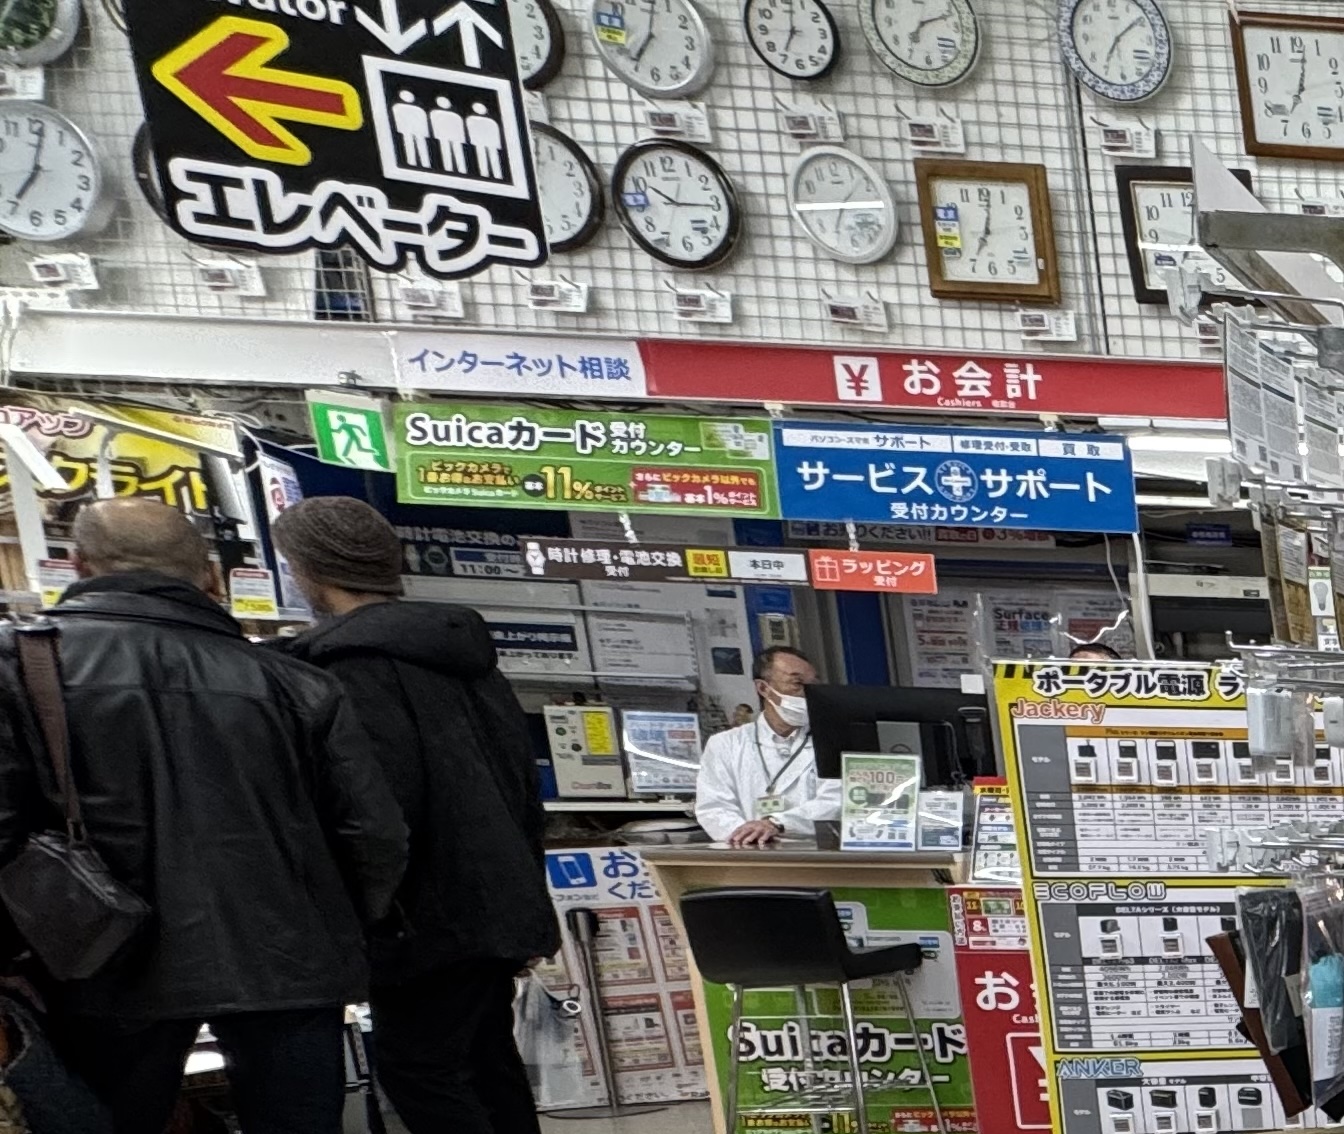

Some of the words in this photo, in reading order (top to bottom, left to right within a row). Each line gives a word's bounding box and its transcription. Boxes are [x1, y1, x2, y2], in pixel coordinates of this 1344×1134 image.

[168, 156, 539, 273] エレベーター
[408, 348, 631, 381] インターネット相談
[901, 358, 1043, 400] お会計
[937, 397, 982, 408] Cashiers
[407, 413, 607, 454] Suicaカード
[610, 421, 646, 440] 受付
[611, 439, 702, 457] カウンター
[874, 434, 931, 450] サポート
[796, 461, 934, 496] サービス
[980, 468, 1112, 503] サポート
[890, 502, 1028, 523] 受付カウンター
[841, 558, 926, 576] ラッピング
[1034, 671, 1207, 698] ポータブル電源
[1012, 699, 1106, 723] Jackery
[1057, 1059, 1143, 1078] ANKER
